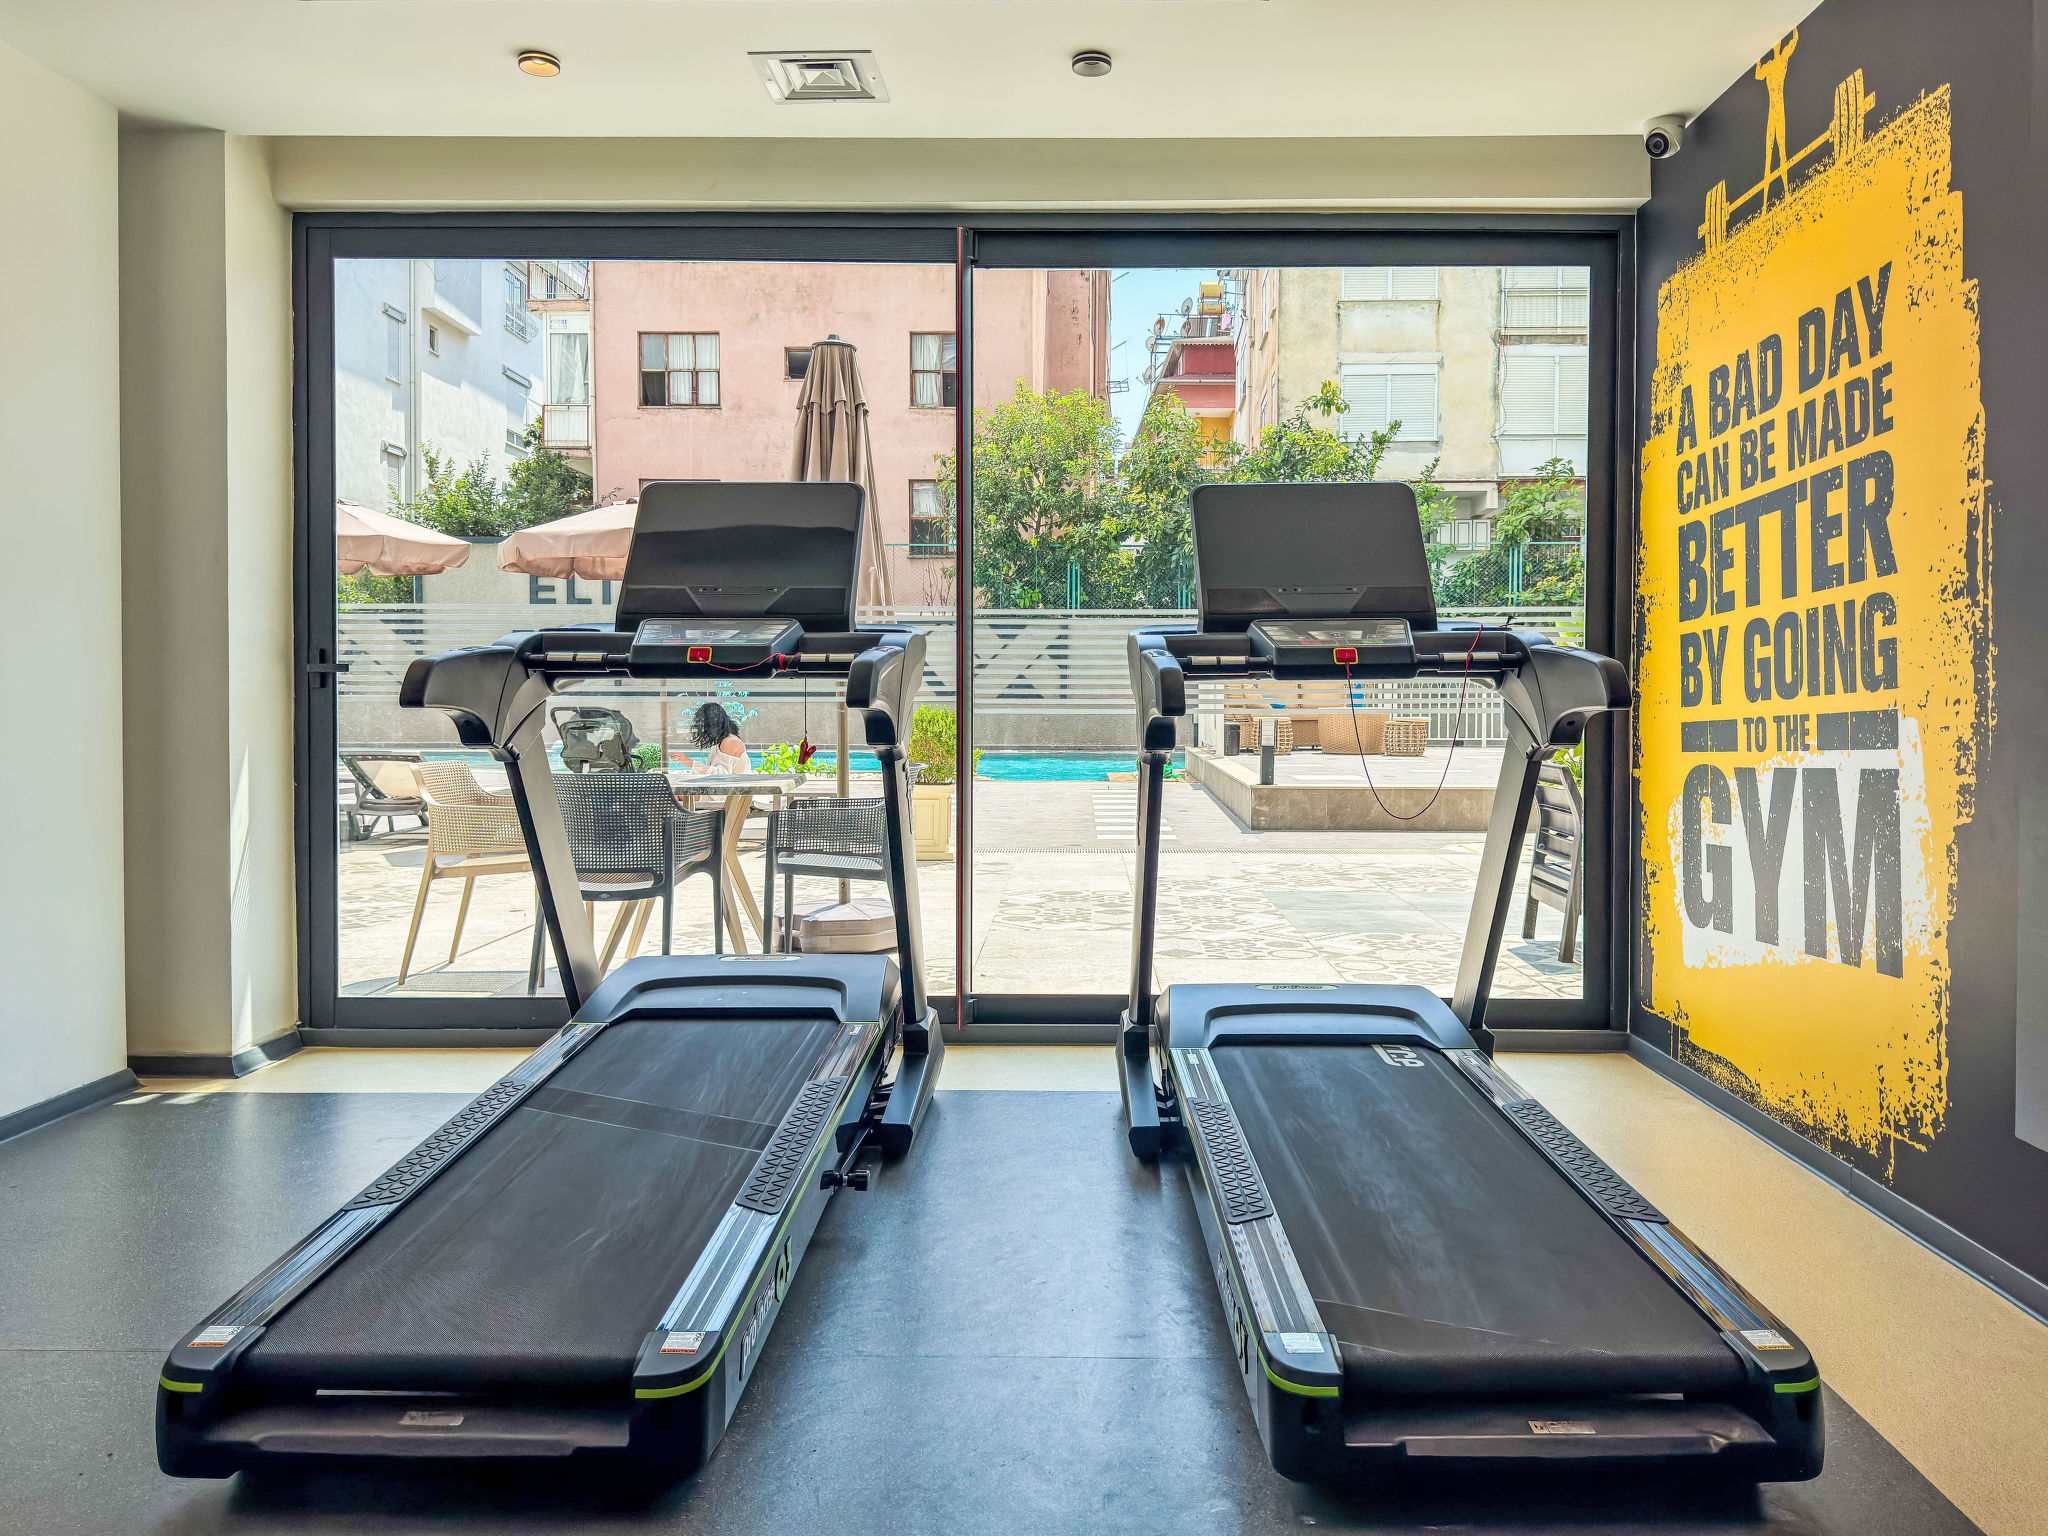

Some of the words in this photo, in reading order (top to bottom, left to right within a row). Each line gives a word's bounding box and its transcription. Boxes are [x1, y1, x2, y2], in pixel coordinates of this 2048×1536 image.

[1676, 384, 1697, 456] A
[1709, 333, 1782, 439] BAD
[1798, 260, 1892, 395] DAY
[1677, 441, 1729, 515] CAN
[1739, 418, 1775, 491] BE
[1787, 360, 1894, 472] MADE
[1678, 450, 1898, 623] BETTER
[1680, 625, 1728, 707] BY
[1743, 592, 1899, 703] GOING
[1742, 716, 1768, 753] TO
[1773, 713, 1810, 752] THE
[1682, 764, 1903, 979] GYM
